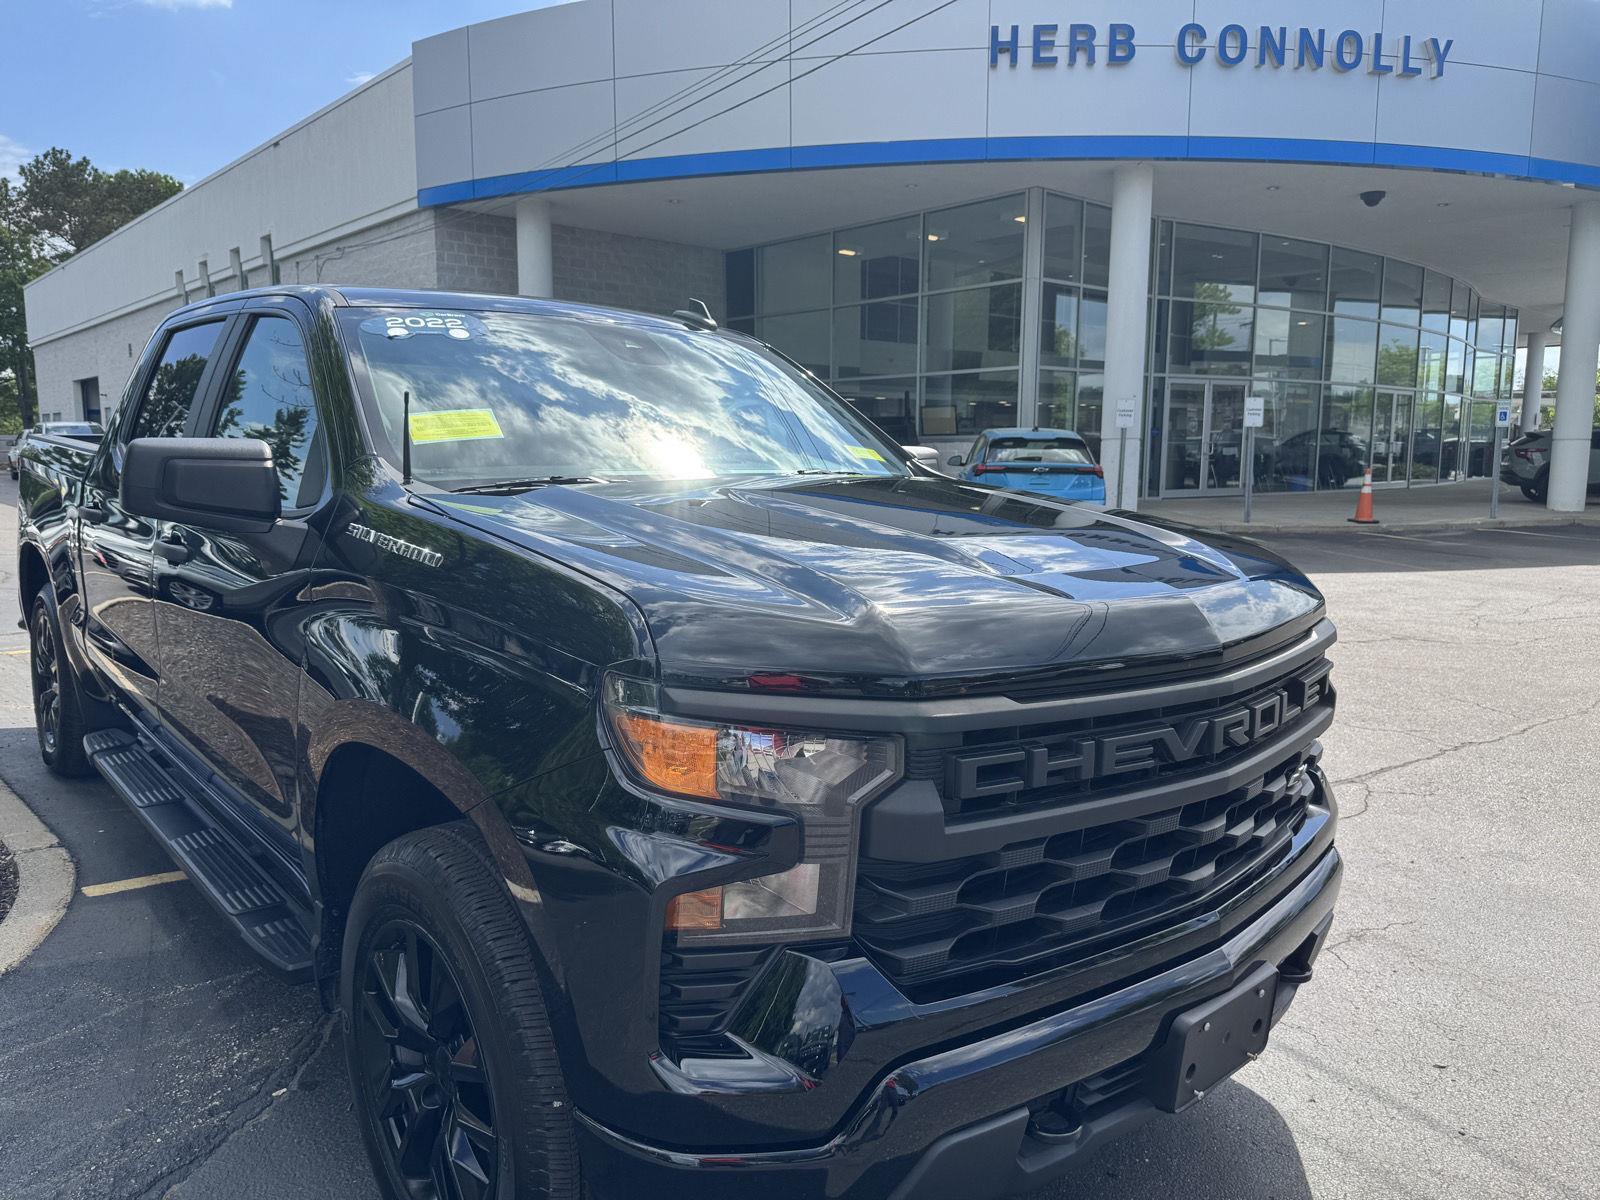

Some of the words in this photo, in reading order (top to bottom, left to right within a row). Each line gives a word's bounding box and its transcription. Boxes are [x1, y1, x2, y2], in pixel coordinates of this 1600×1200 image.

[990, 24, 1137, 67] HERB
[1176, 23, 1454, 79] CONNOLLY
[385, 316, 467, 329] 2022
[345, 522, 444, 568] SILVERADO
